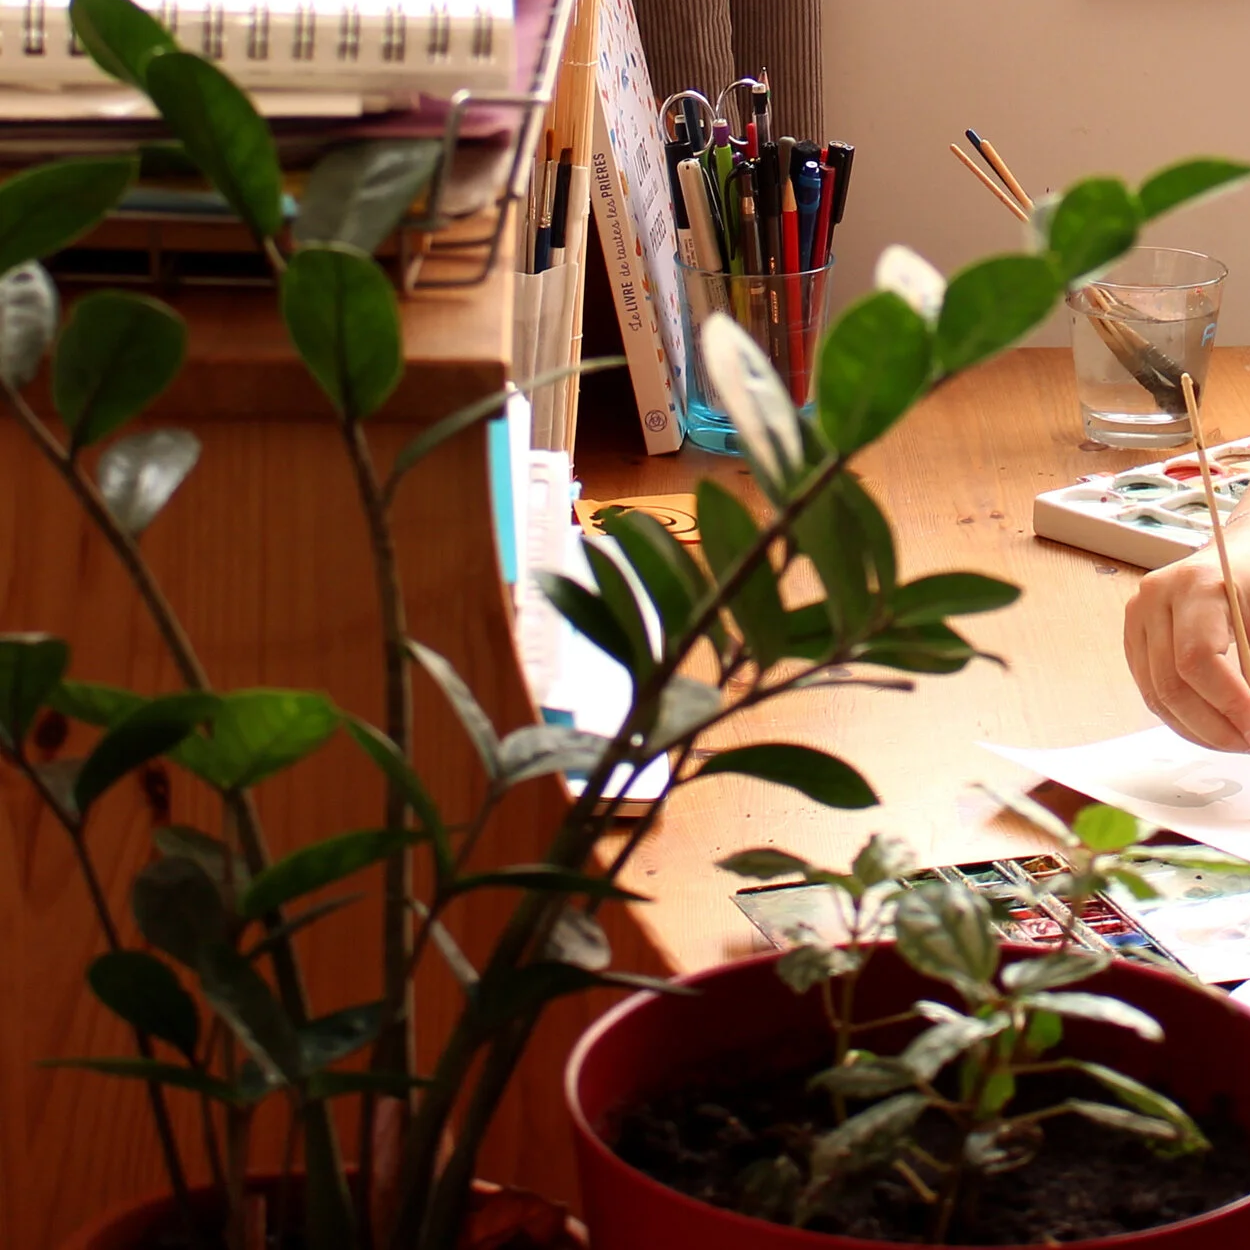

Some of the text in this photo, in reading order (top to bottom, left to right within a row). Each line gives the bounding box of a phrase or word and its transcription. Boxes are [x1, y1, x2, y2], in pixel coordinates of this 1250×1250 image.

[593, 153, 613, 198] PRIÈRES
[607, 198, 617, 218] les
[612, 220, 626, 260] toutes
[620, 262, 631, 276] de
[621, 281, 638, 311] LIVRE
